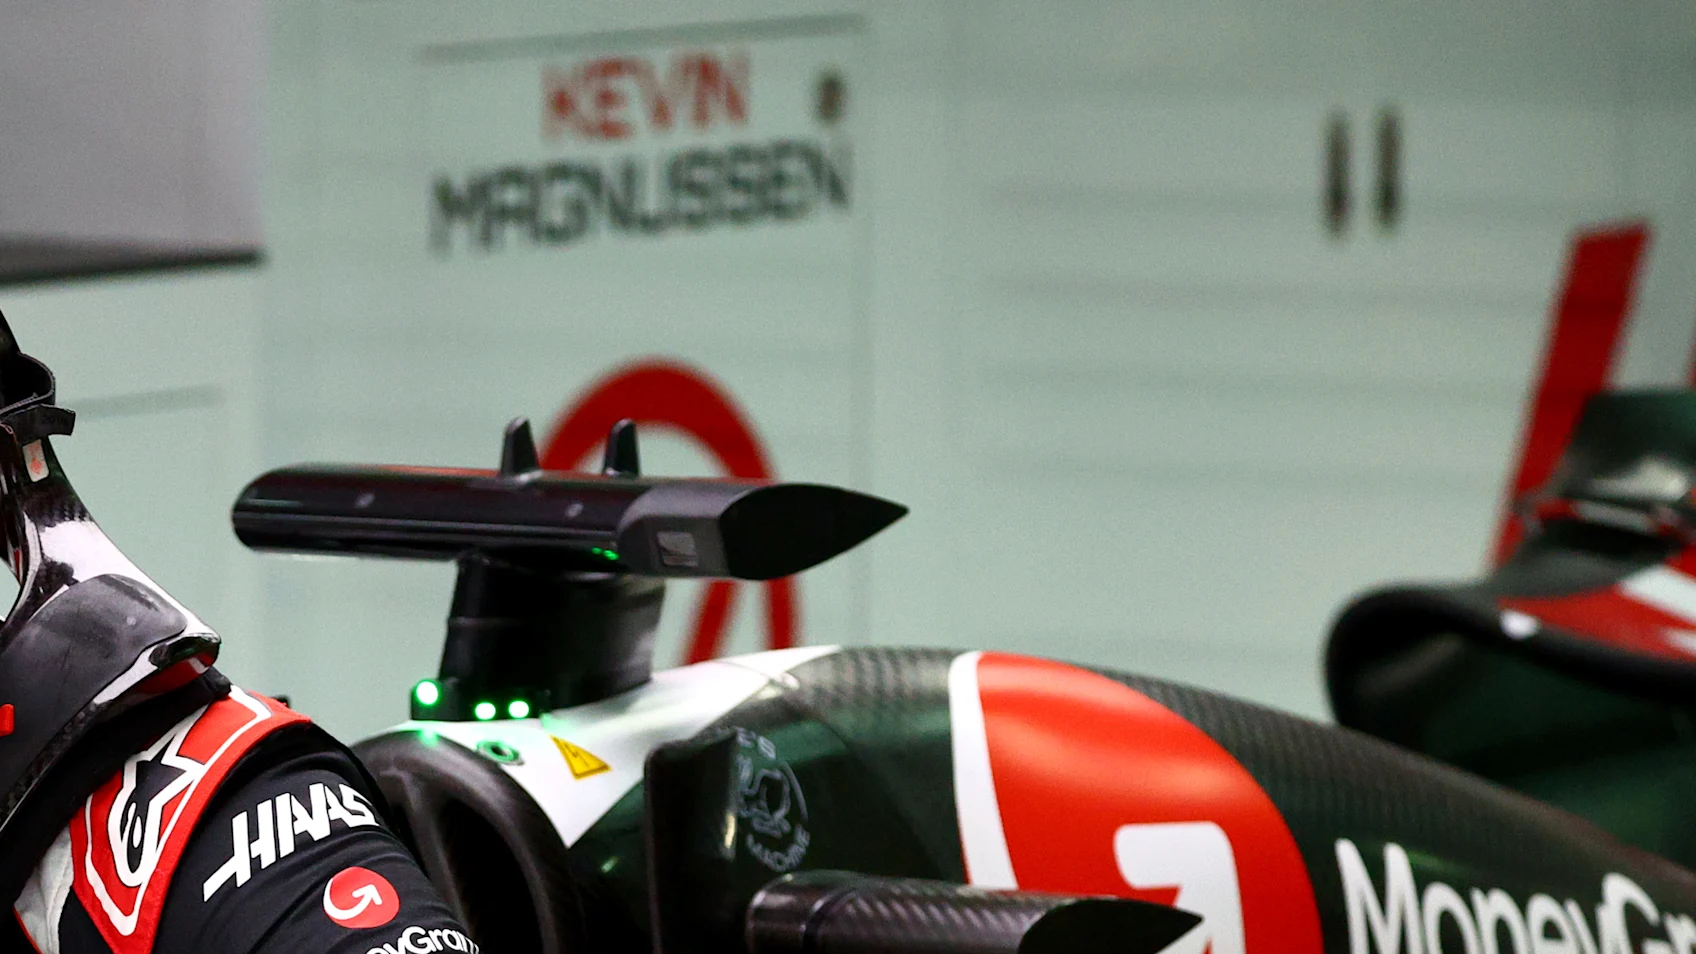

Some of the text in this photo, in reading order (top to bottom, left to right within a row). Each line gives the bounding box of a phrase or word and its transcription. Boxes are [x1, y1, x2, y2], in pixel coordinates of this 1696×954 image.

[541, 48, 752, 142] KEVIN
[430, 134, 853, 256] MAGNUSSEN
[203, 783, 381, 902] HAAS
